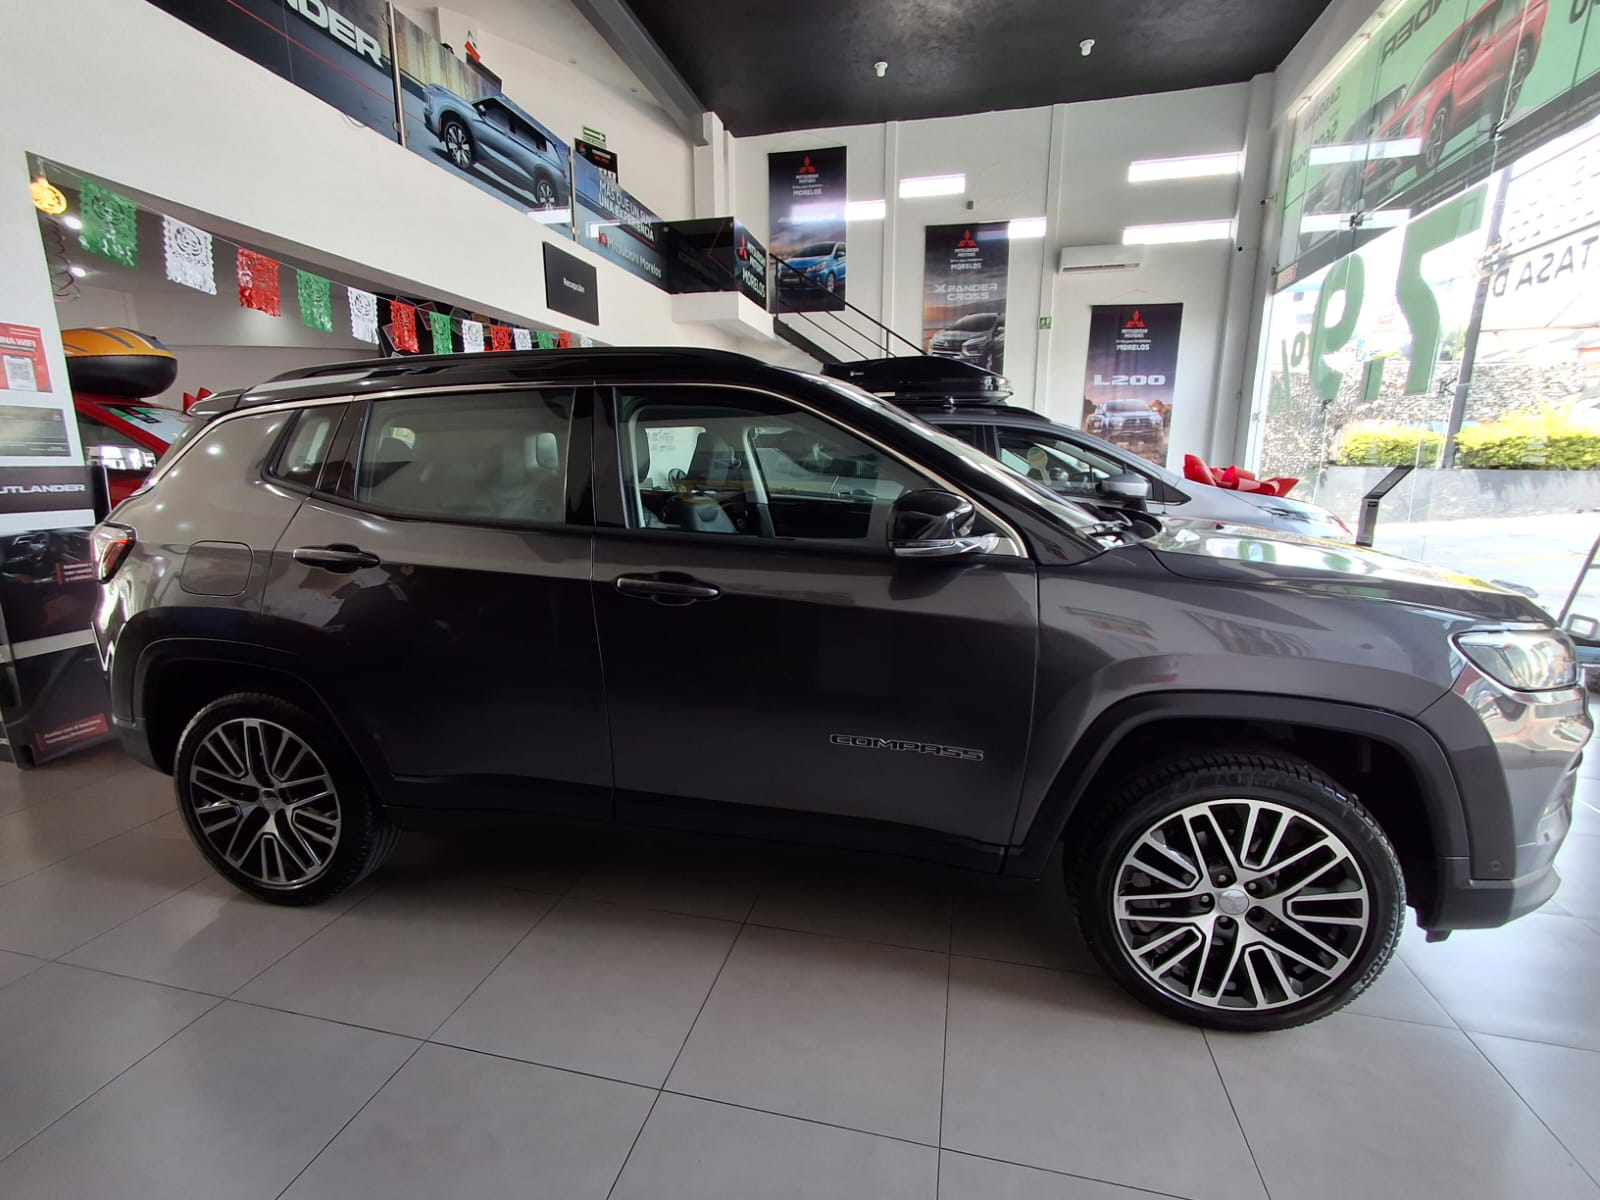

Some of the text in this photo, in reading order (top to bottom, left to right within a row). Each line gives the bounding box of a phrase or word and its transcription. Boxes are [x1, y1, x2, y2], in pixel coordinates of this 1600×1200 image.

[950, 262, 982, 271] MORELOS
[742, 266, 766, 299] MORELOS
[947, 292, 990, 301] CROSS
[1116, 343, 1151, 351] MORELOS
[1093, 374, 1167, 386] L200
[830, 733, 984, 761] COMPASS
